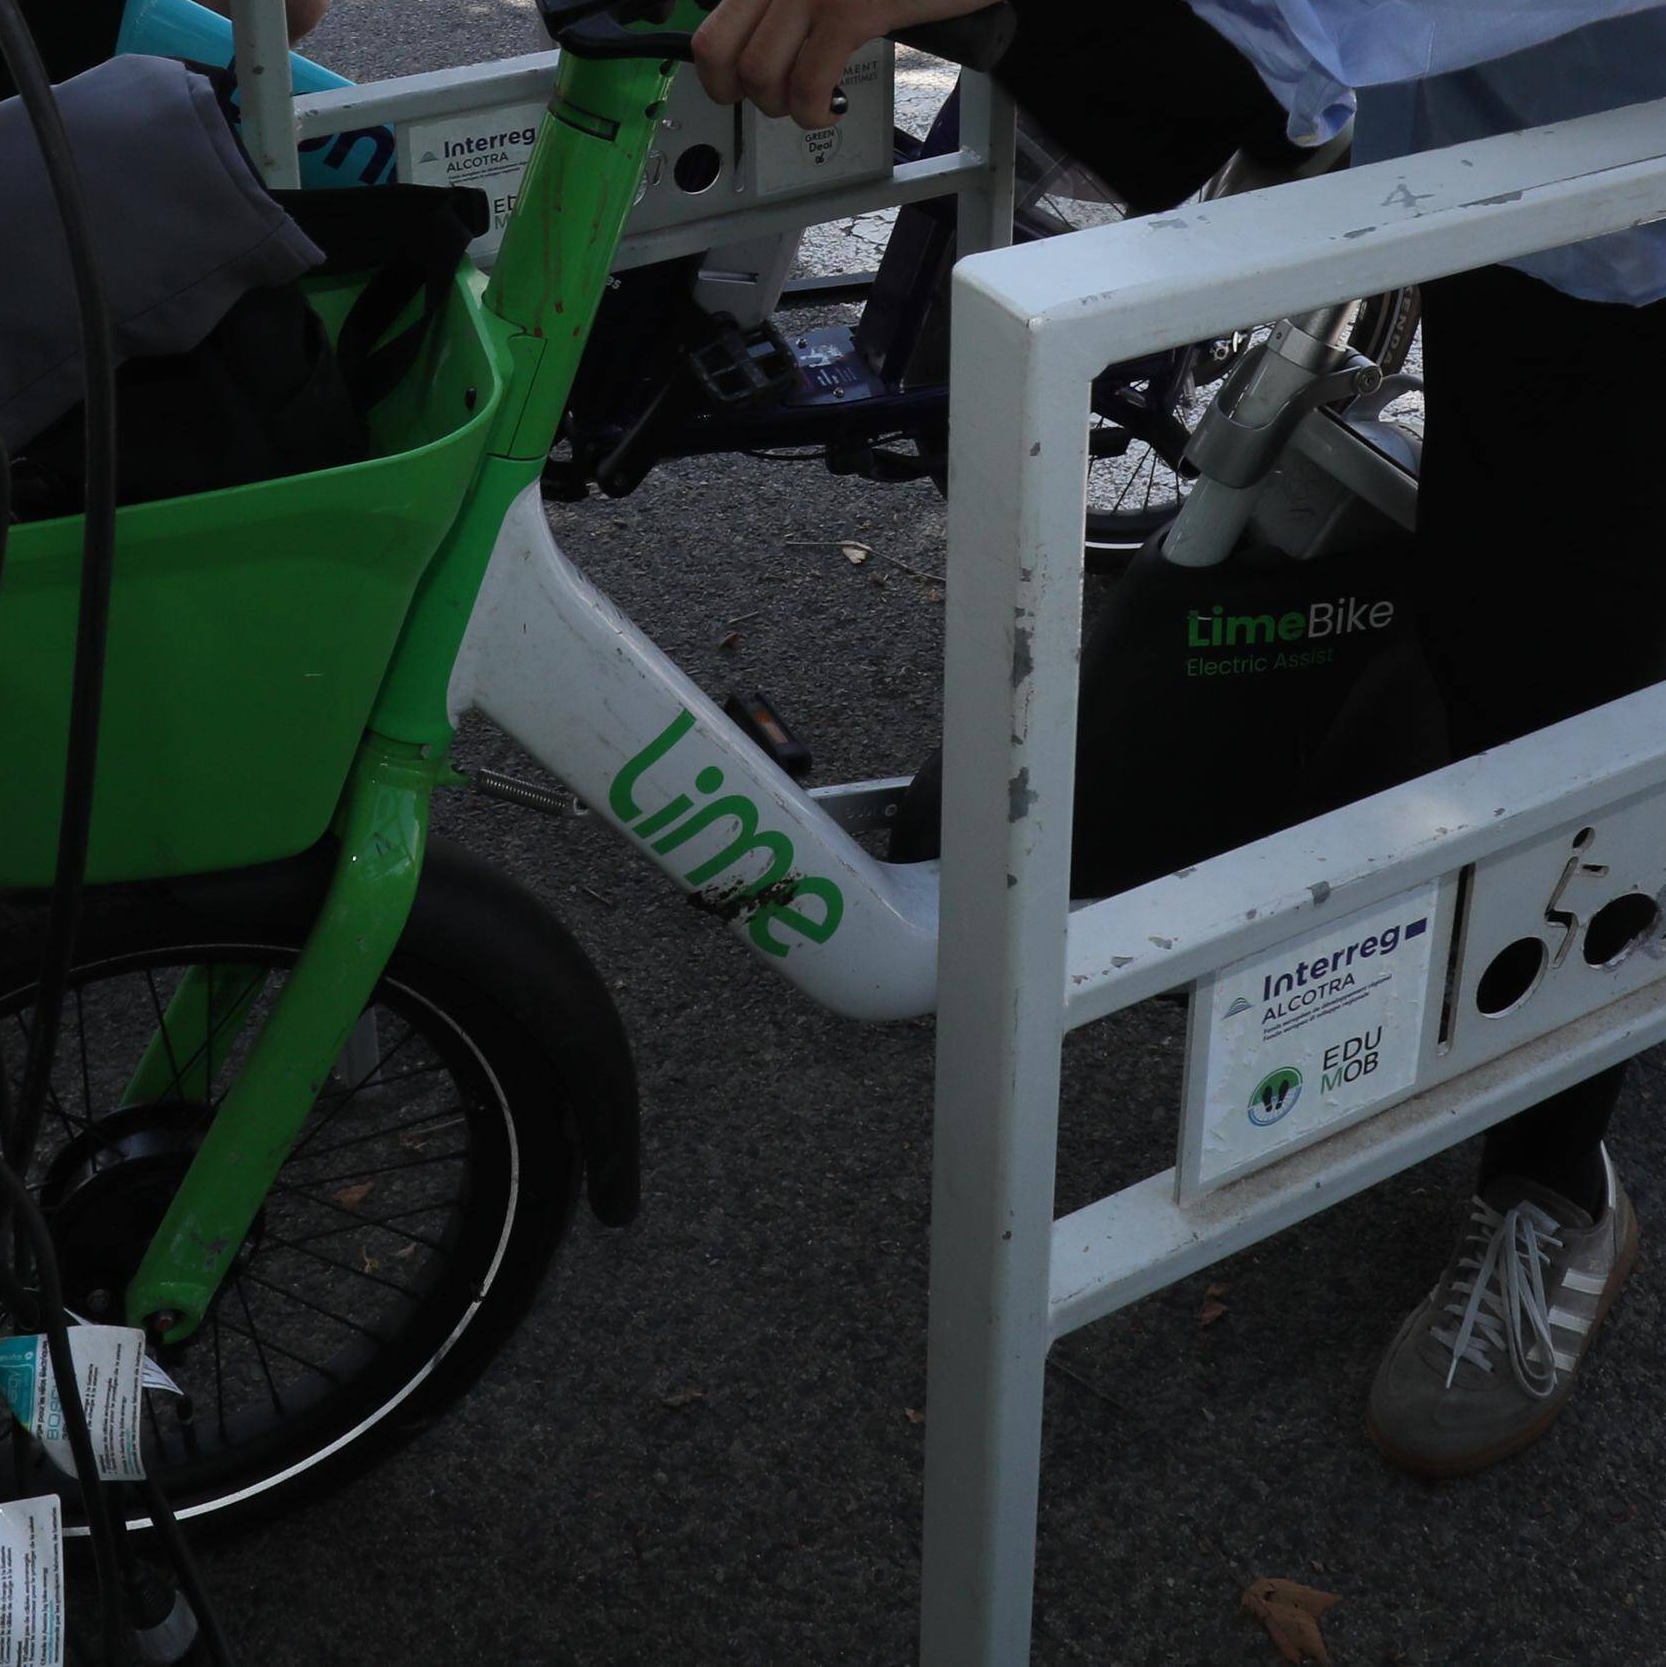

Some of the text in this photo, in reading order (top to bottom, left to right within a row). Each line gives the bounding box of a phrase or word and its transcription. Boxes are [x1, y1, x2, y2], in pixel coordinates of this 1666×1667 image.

[444, 127, 536, 159] Interreg
[446, 151, 509, 174] ALCOTRA
[1186, 596, 1395, 648] LimeBike
[1186, 647, 1335, 677] Electric Assist
[609, 710, 844, 959] Lime
[1262, 924, 1401, 1003] Interreg
[1261, 972, 1356, 1025] ALCOTRA
[1323, 1025, 1383, 1072] EDU
[1320, 1050, 1380, 1095] MOB
